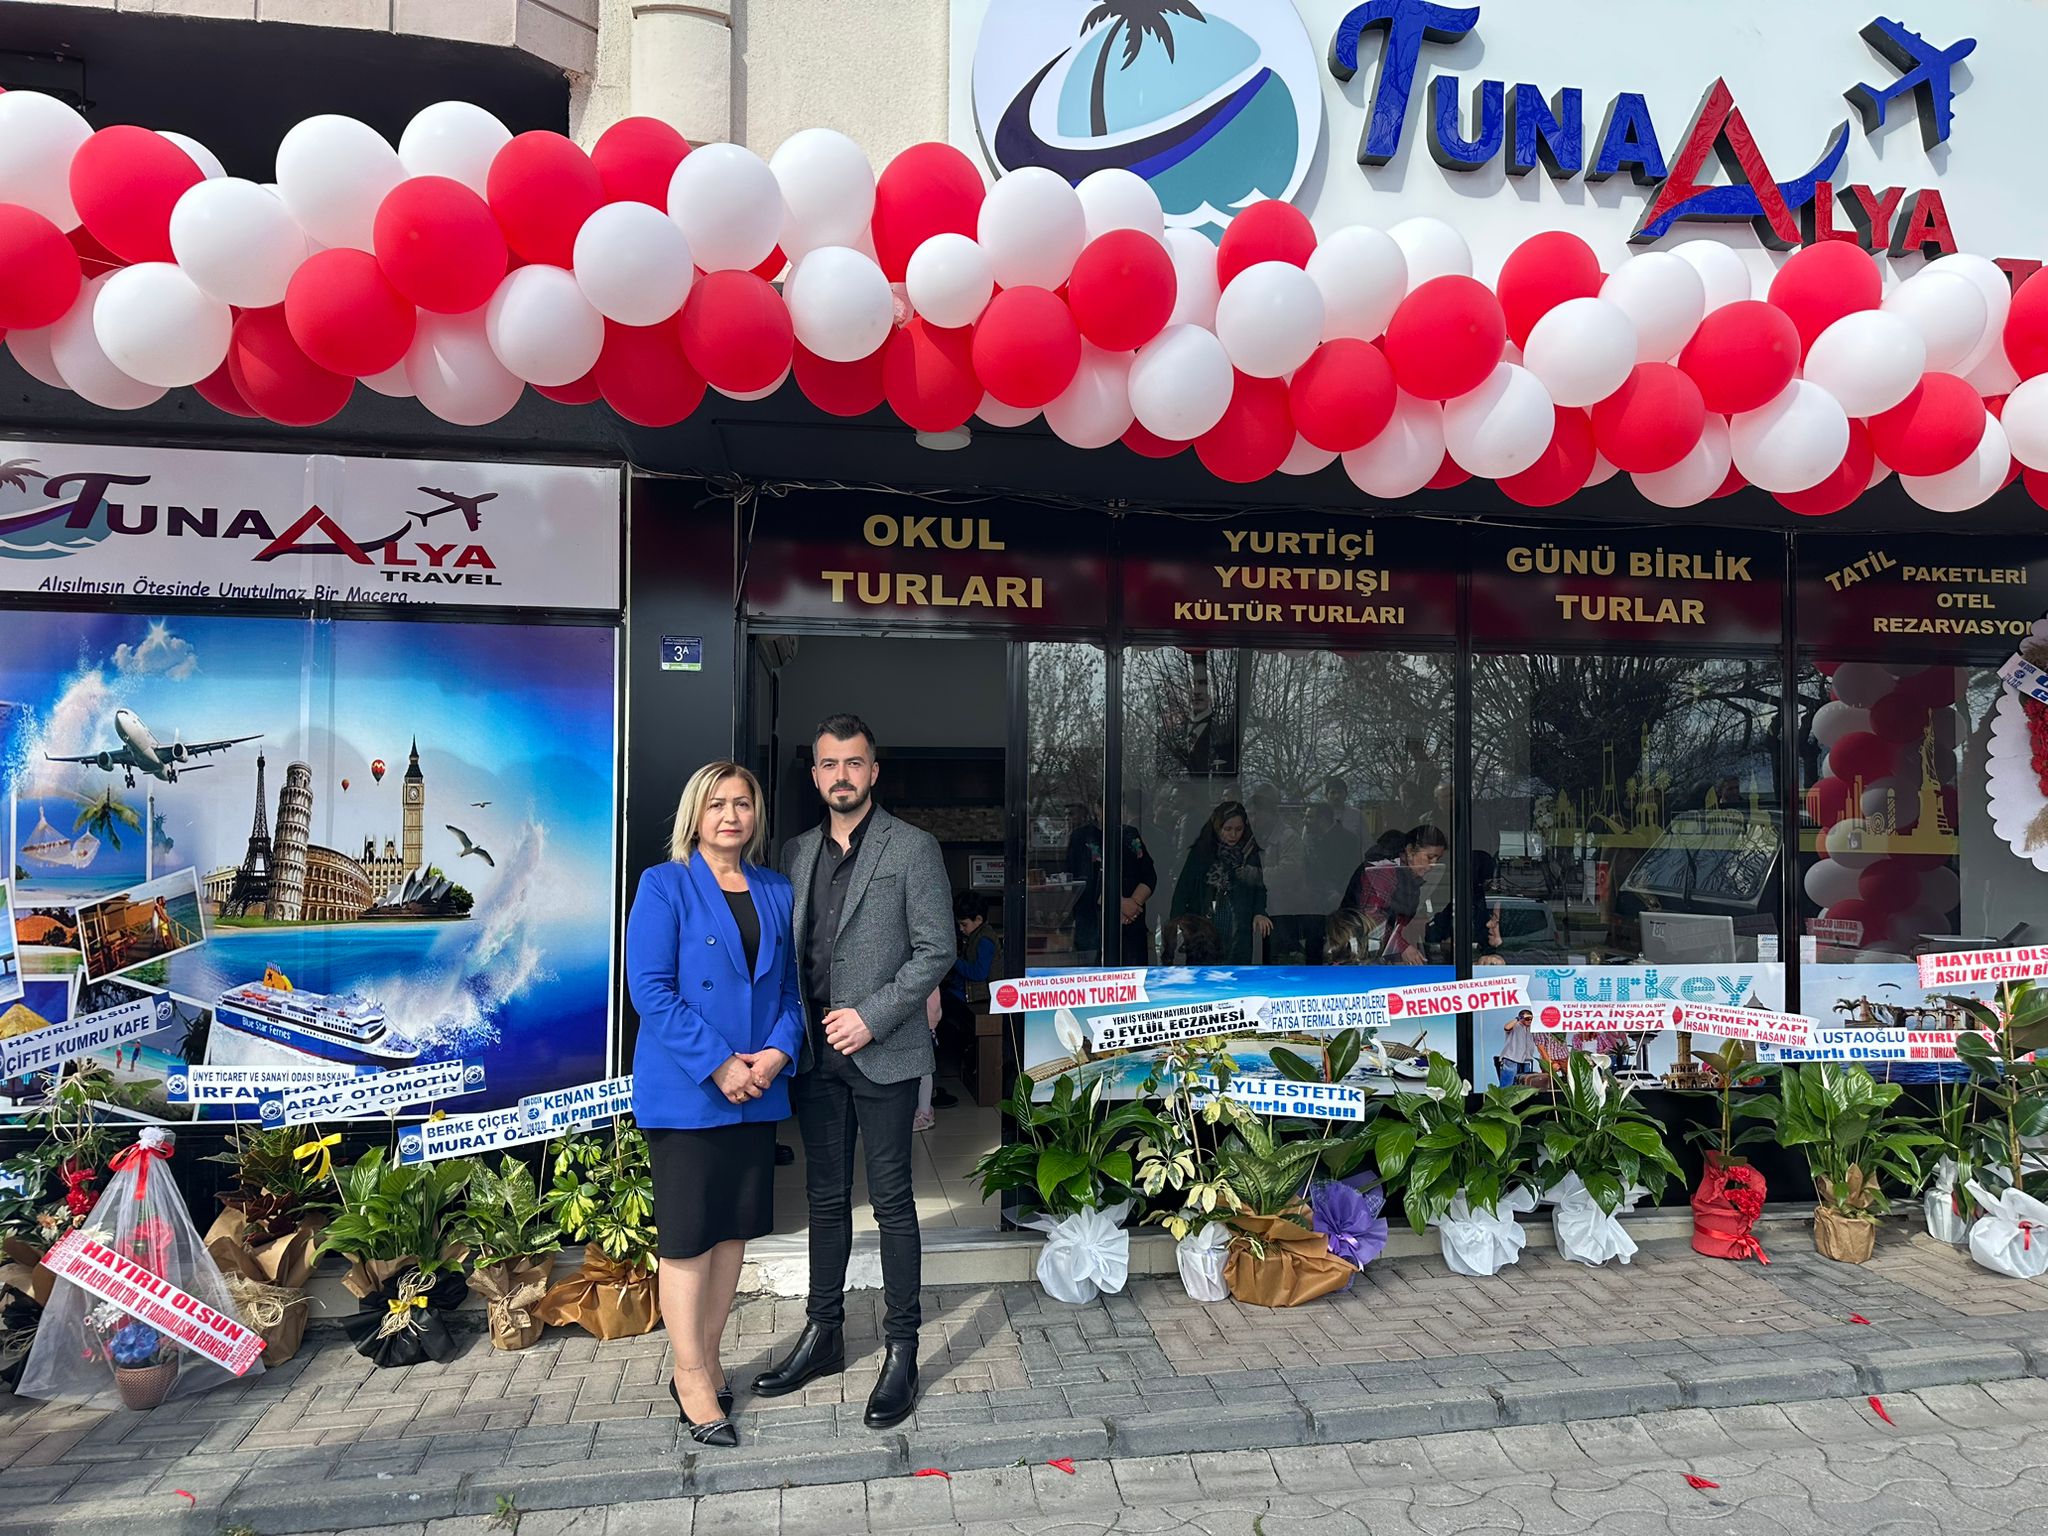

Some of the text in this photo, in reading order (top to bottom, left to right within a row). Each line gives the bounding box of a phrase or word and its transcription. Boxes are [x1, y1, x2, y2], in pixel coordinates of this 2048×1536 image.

[1328, 0, 1958, 257] TUNA ALYA
[43, 472, 497, 569] TUNA ALYA
[863, 514, 1005, 550] OKUL
[1222, 528, 1374, 561] YURTİÇİ
[1506, 543, 1752, 582] GÜNÜ BİRLİK
[1824, 550, 2027, 592] TATİL PAKETLERİ
[132, 575, 210, 598] Ötesinde
[219, 582, 307, 600] Unutulmaz
[314, 584, 339, 601] Bir
[380, 570, 502, 586] TRAVEL
[821, 571, 1043, 608] TURLARI
[1214, 566, 1389, 597] YURTDIŞI
[1174, 599, 1405, 624] KÜLTÜR TURLARI
[1555, 594, 1706, 625] TURLAR
[1936, 593, 1996, 609] OTEL
[1935, 948, 2048, 967] HAYIRLI OLS
[1018, 972, 1136, 988] HAYIRLI OLSUN DİLEKLERİMİZLE
[1936, 969, 1967, 984] ASLI
[1971, 968, 1987, 981] VE
[2033, 961, 2048, 976] Bİ
[1020, 988, 1086, 1010] NEWMOON
[1089, 982, 1137, 1005] TURİZM
[1402, 977, 1517, 996] HAYIRLI OLSUN DİLEKLERİMİZLE
[1534, 968, 1753, 1006] Turkey
[1112, 1015, 1128, 1026] YENİ
[1129, 1014, 1137, 1025] İŞ
[1137, 1010, 1163, 1022] YERİNİZ
[1164, 1007, 1190, 1018] HAYIRLI
[1191, 1004, 1213, 1014] OLSUN
[1270, 999, 1296, 1015] HAYIRLI
[1297, 998, 1306, 1013] VE
[1307, 998, 1321, 1012] BOL
[1322, 996, 1361, 1013] KAZANÇLAR
[1406, 995, 1463, 1016] RENOS
[1467, 987, 1520, 1009] OPTİK
[1562, 1010, 1604, 1019] USTA
[1608, 1008, 1665, 1019] İNŞAAT
[1714, 1006, 1745, 1015] YERİNİZ
[1747, 1011, 1779, 1020] HAYIRLI
[1781, 1016, 1808, 1024] OLSUN
[8, 1003, 141, 1048] HAYIRLI OLSUN
[242, 1016, 291, 1040] Blue Star Ferries
[1103, 1028, 1115, 1040] 9
[1119, 1021, 1166, 1038] EYLÜL
[1169, 1008, 1246, 1031] ECZANESİ
[1271, 1015, 1300, 1030] FATSA
[1301, 1013, 1336, 1028] TERMAL
[1338, 1013, 1344, 1026] &
[1346, 1012, 1364, 1026] SPA
[1365, 1011, 1389, 1025] OTEL
[1562, 1019, 1665, 1031] HAKAN USTA
[1683, 1019, 1709, 1032] İHSAN
[1711, 1024, 1749, 1038] YILDIRIM
[1756, 1031, 1786, 1044] HASAN
[1788, 1034, 1807, 1047] IŞIK
[1685, 1010, 1808, 1034] FORMEN YAPI
[6, 1015, 150, 1076] ÇİFTE KUMRU KAFE
[1098, 1020, 1260, 1050] ECZ. ENGİN OCAKDAN
[1780, 1048, 1845, 1061] Hayırlı
[1849, 1047, 1905, 1060] Olsun
[192, 1070, 213, 1082] ÜNYE
[215, 1069, 247, 1082] TİCARET
[250, 1072, 260, 1082] VE
[261, 1069, 290, 1082] SANAYİ
[291, 1072, 315, 1082] ODASI
[284, 1060, 461, 1096] HAYIRLI OLSUN
[194, 1084, 269, 1098] İRFAN
[286, 1072, 462, 1111] ARAF OTOMOTİV
[290, 1085, 458, 1120] CEVAT GÜLER
[543, 1087, 595, 1111] KENAN
[598, 1076, 633, 1098] SELİ
[1274, 1083, 1362, 1102] ESTETİK
[551, 1110, 570, 1126] AK
[571, 1099, 609, 1122] PARTİ
[1293, 1101, 1356, 1118] Olsun
[427, 1121, 474, 1138] BERKE
[479, 1111, 519, 1130] ÇİÇEK
[428, 1132, 500, 1155] MURAT
[65, 1254, 93, 1281] ÜNYE
[84, 1268, 115, 1292] ALEVİ
[104, 1279, 140, 1308] KÜLTÜR
[134, 1296, 151, 1314] VE
[144, 1301, 200, 1343] YARDIMLAŞMA
[81, 1240, 172, 1299] HAYIRLI
[171, 1292, 245, 1342] OLSUN
